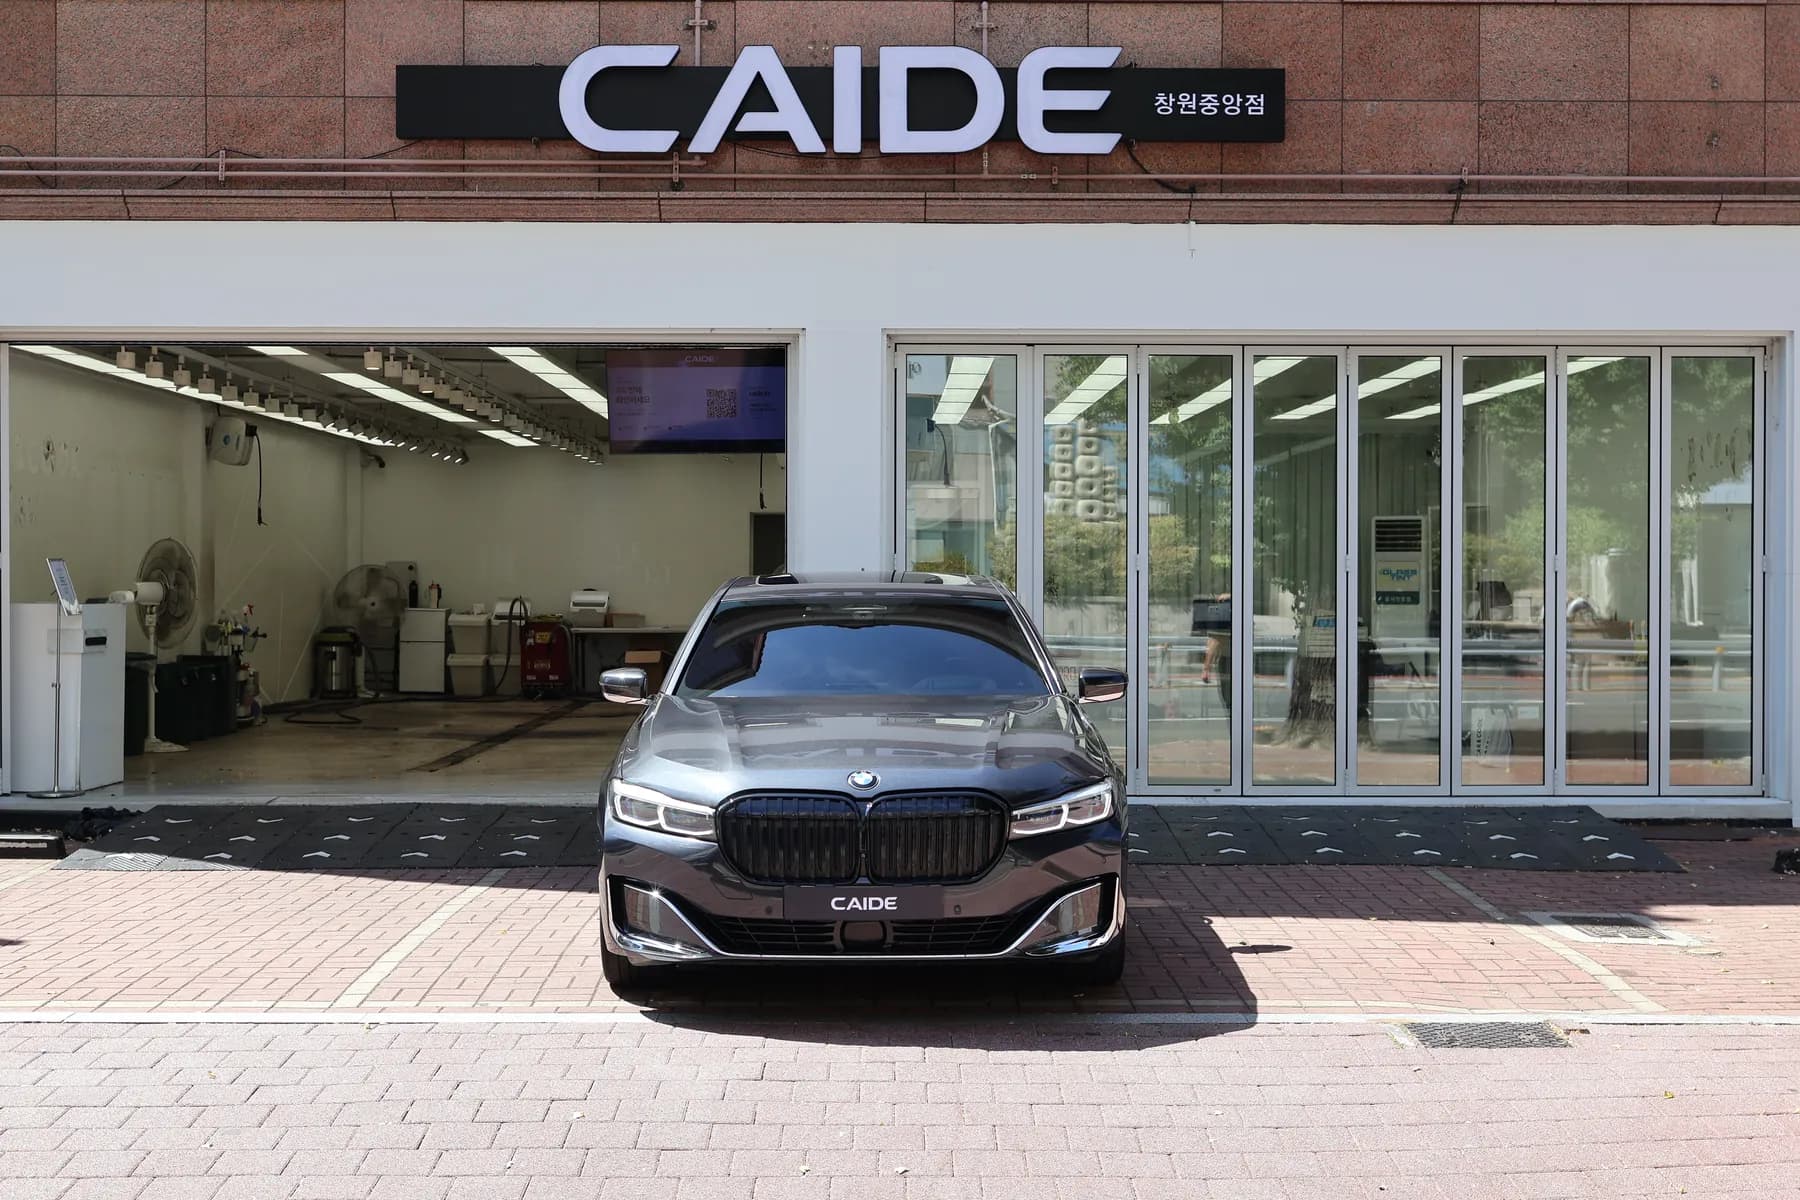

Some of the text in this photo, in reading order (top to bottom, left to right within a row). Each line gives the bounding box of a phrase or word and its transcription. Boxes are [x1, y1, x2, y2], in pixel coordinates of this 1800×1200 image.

[558, 45, 1122, 154] CAIDE
[1154, 92, 1265, 116] 창원중앙점
[830, 896, 898, 911] CAIDE
